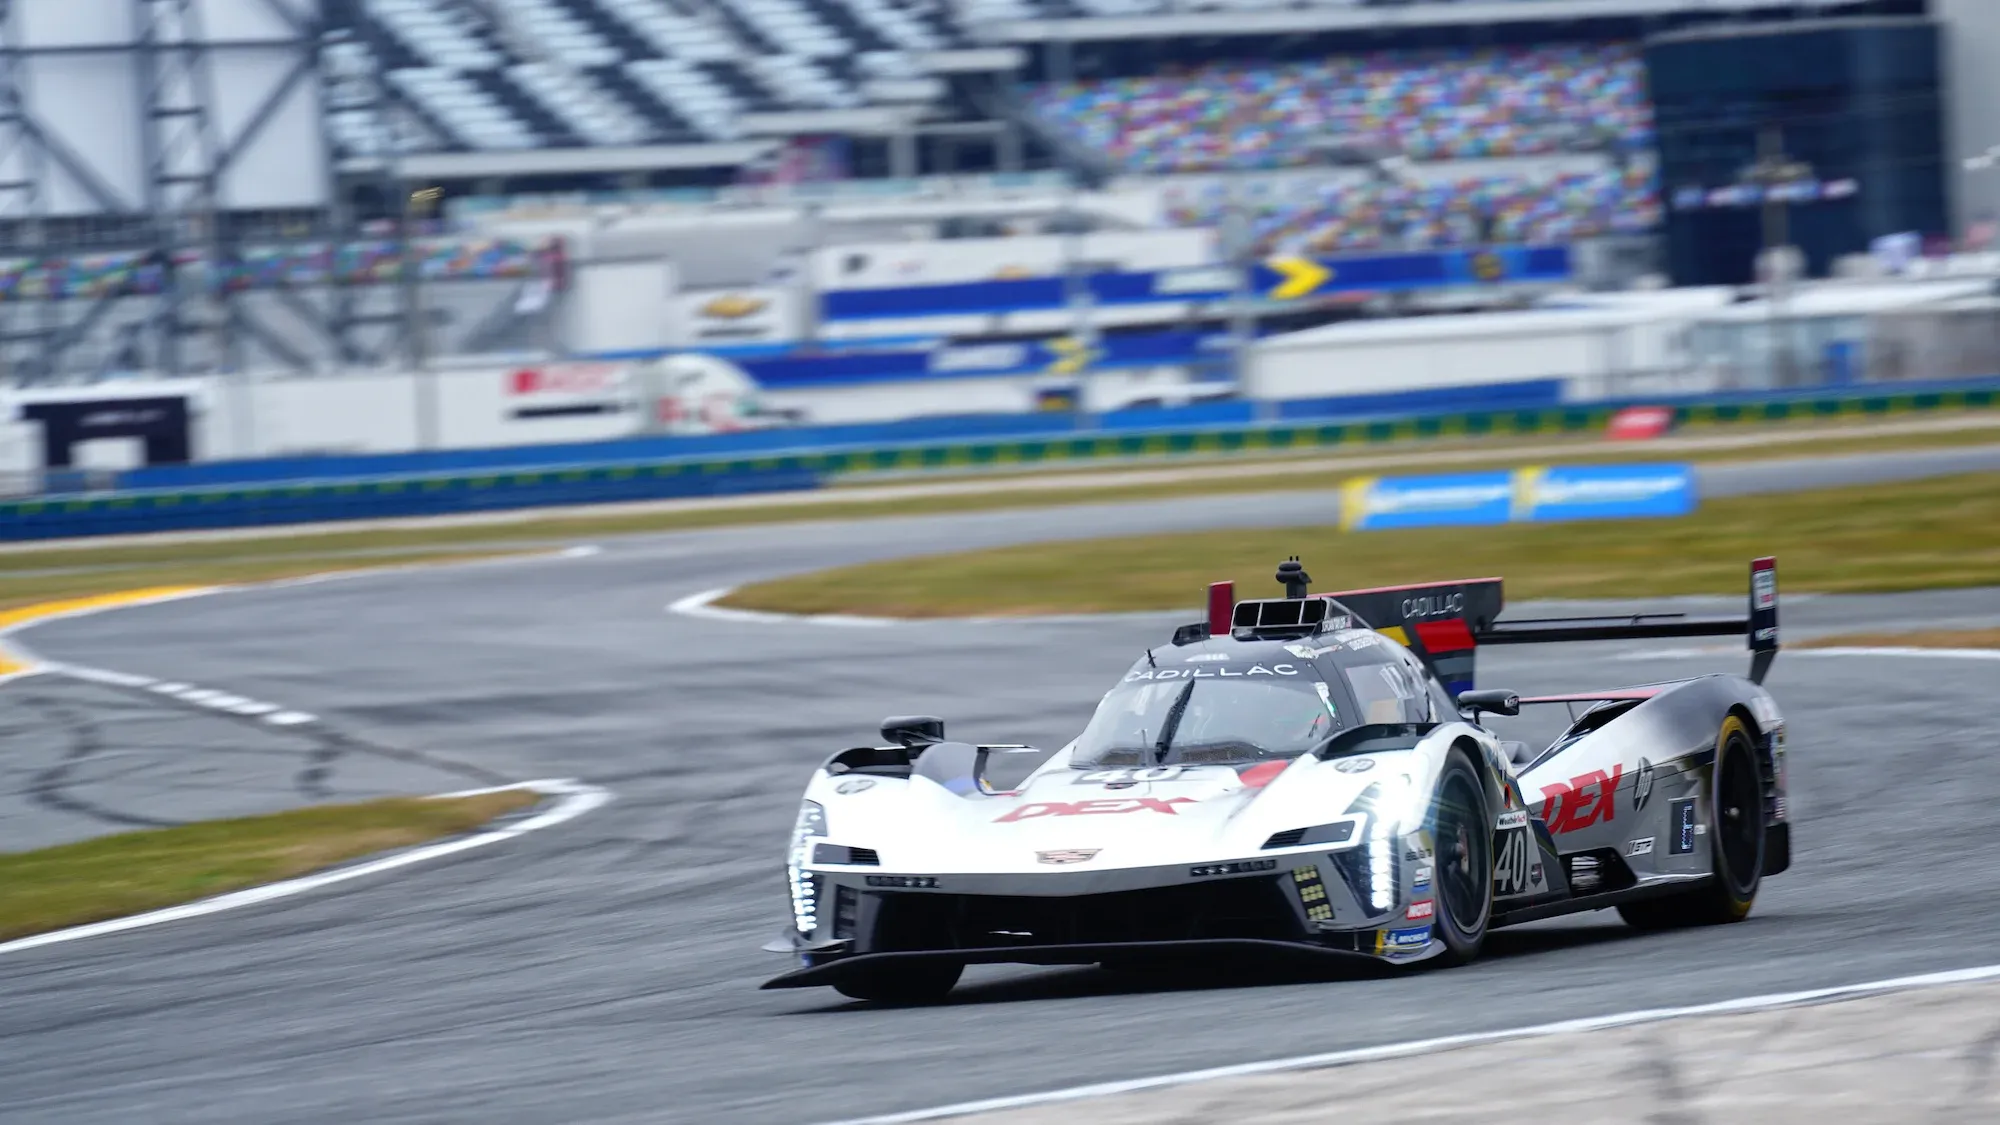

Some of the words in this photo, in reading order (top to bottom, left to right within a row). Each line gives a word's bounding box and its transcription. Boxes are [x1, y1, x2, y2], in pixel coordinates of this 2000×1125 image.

[1401, 592, 1464, 619] CADILLAC
[1123, 663, 1299, 683] CADILLAC
[1081, 765, 1184, 783] 40
[993, 796, 1199, 824] DEX
[1540, 763, 1623, 836] DEX
[1493, 830, 1525, 892] 40
